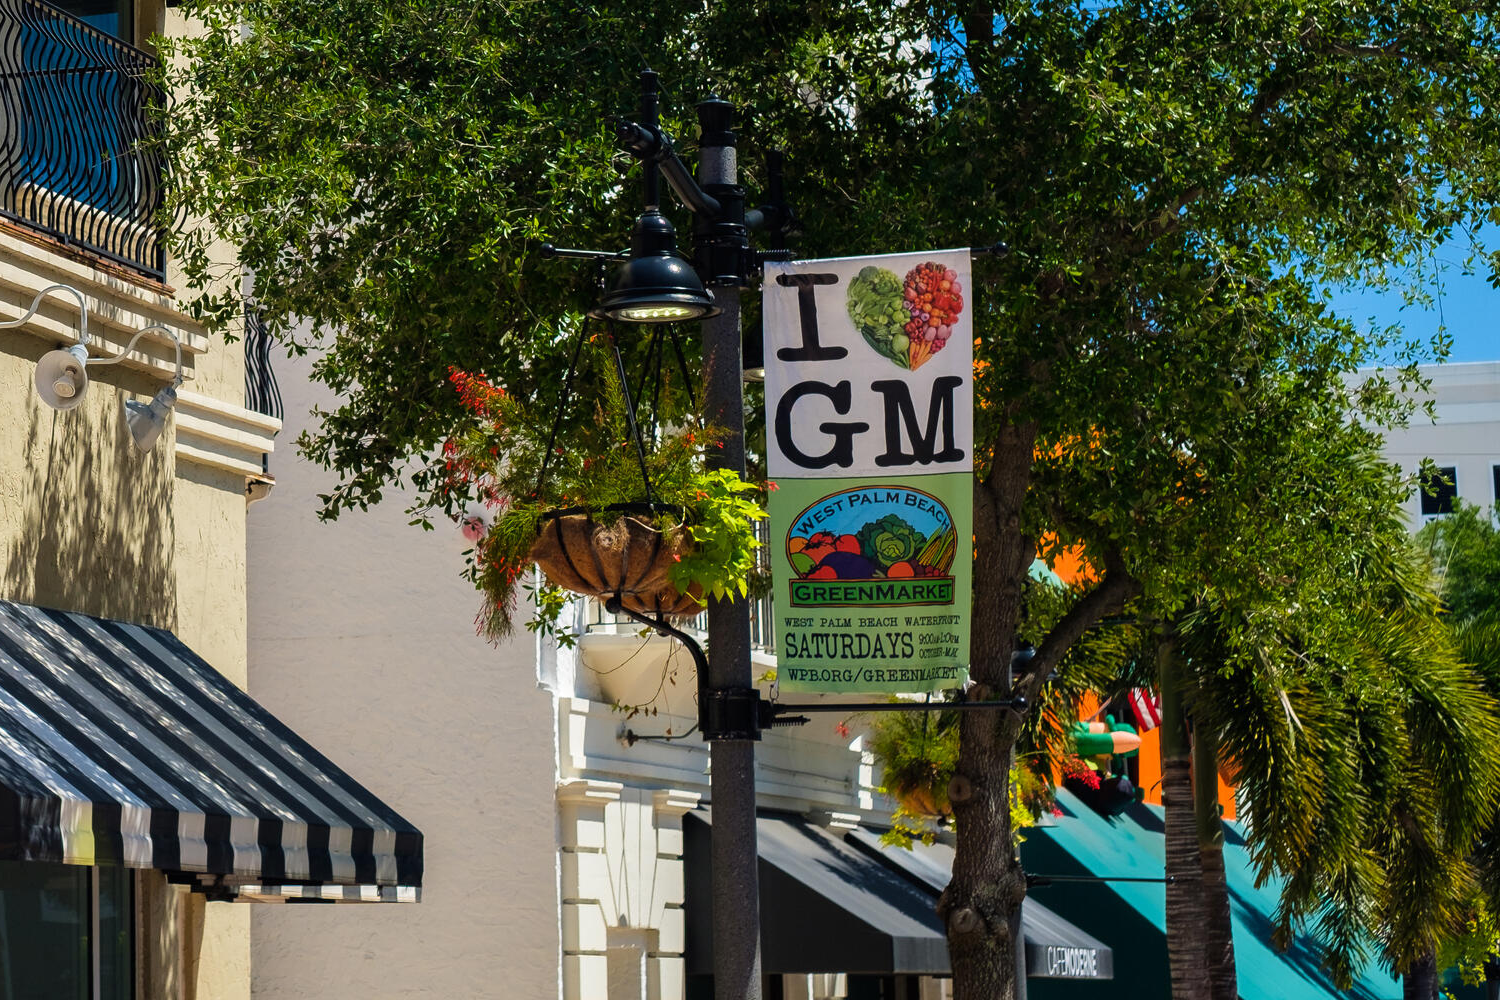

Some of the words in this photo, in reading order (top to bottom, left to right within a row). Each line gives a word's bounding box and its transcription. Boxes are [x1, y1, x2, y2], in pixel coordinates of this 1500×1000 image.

[775, 272, 849, 362] I
[774, 375, 966, 470] GM
[797, 500, 845, 536] WEST
[847, 491, 900, 508] PALM
[903, 492, 951, 531] BEACH
[794, 583, 952, 601] GREENMARKET
[784, 617, 814, 628] WEST
[819, 617, 852, 628] PALM
[858, 616, 898, 627] BEACH
[784, 631, 915, 660] SATURDAYS
